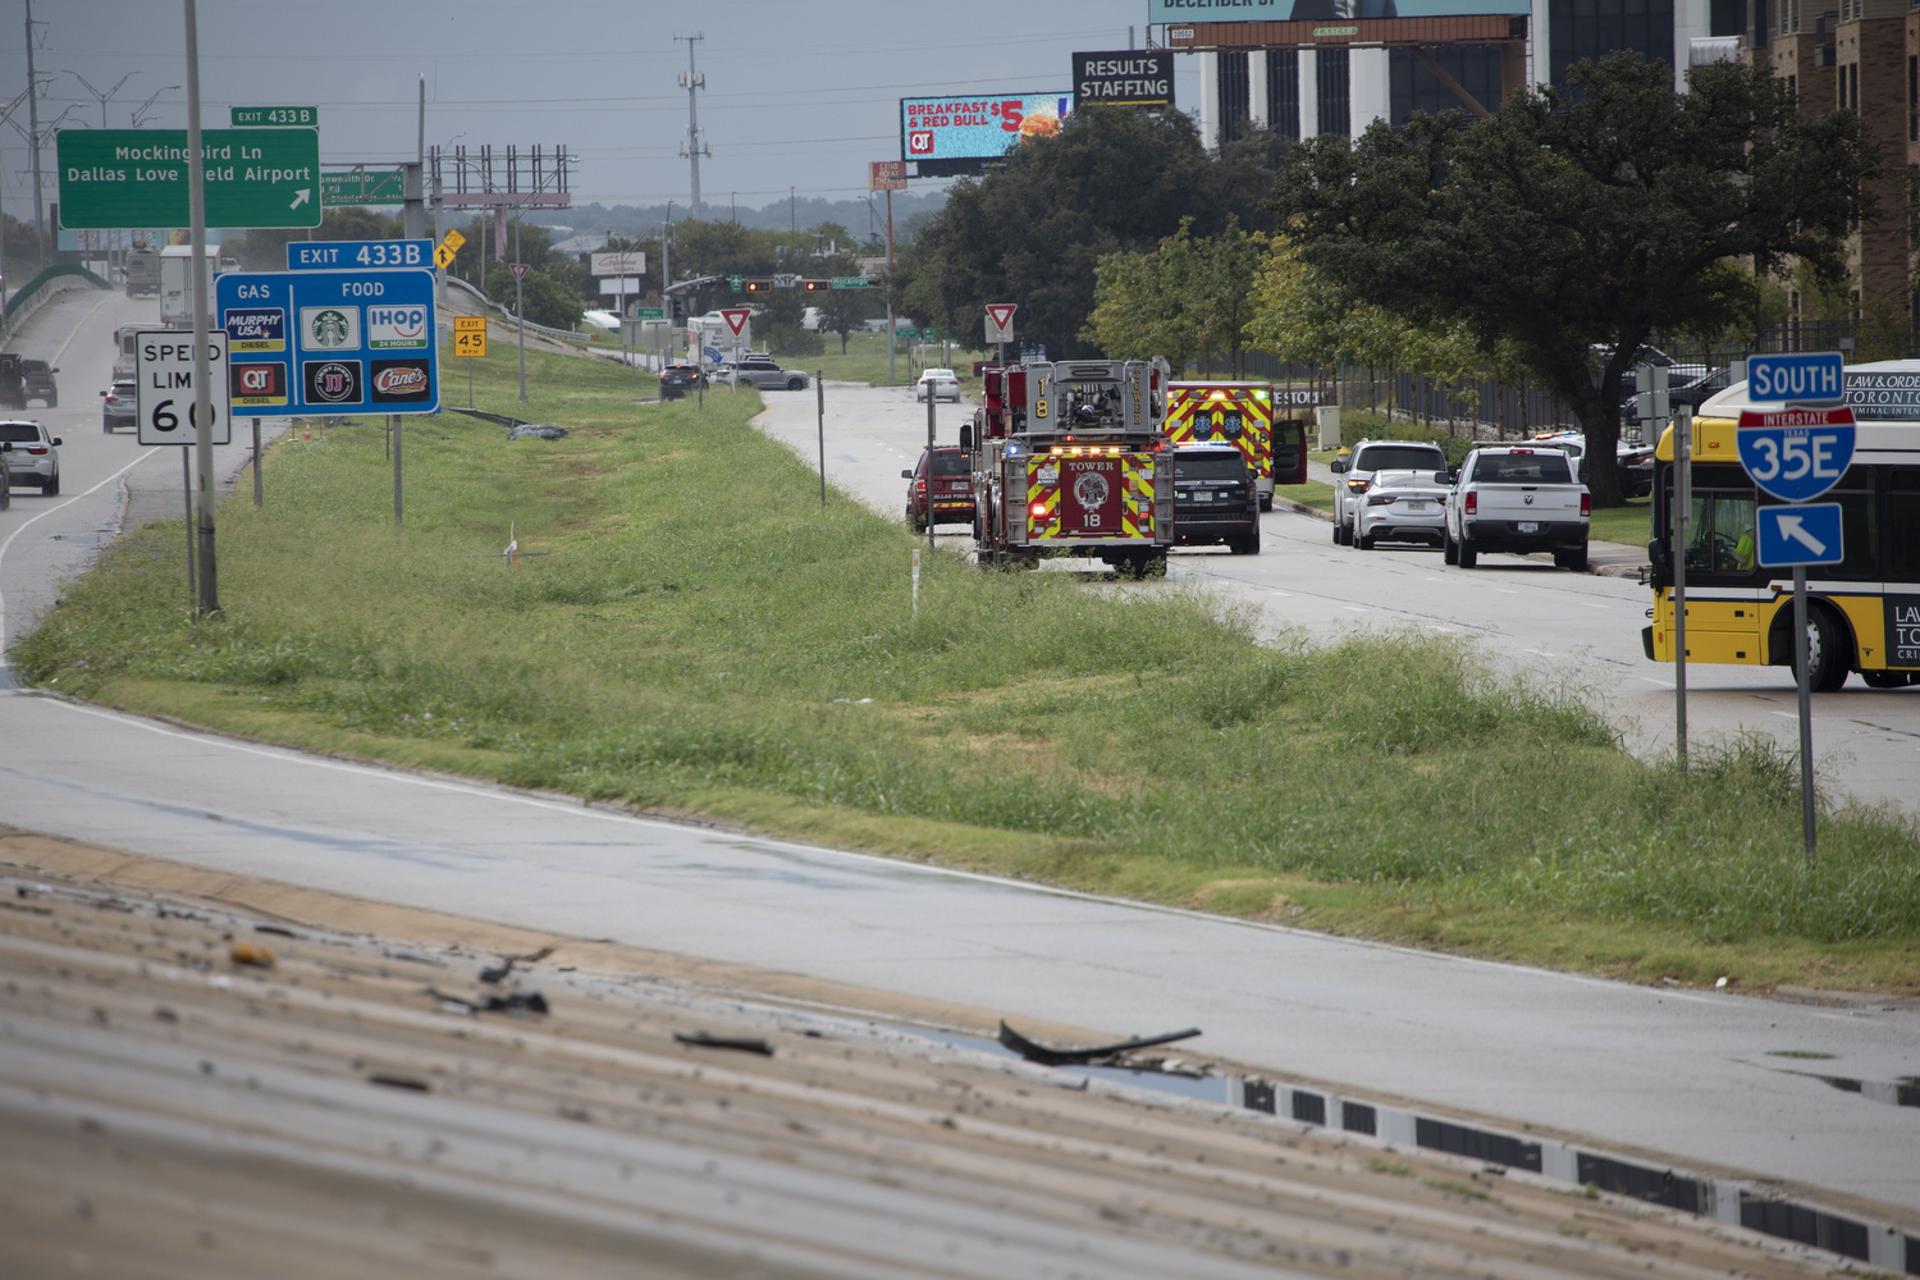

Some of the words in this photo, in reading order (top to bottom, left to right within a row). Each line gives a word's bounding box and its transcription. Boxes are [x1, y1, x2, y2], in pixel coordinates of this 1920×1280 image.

[1085, 59, 1158, 76] RESULTS
[1081, 80, 1168, 97] STAFFING
[908, 102, 989, 115] BREAKFAST
[238, 112, 262, 121] EXIT
[909, 117, 918, 128] &
[923, 116, 950, 127] RED
[953, 115, 989, 126] BULL
[911, 133, 930, 151] QT
[241, 146, 262, 160] Ln
[67, 167, 126, 181] Dallas
[136, 168, 179, 181] Love
[205, 166, 234, 181] eld
[244, 166, 310, 184] Airport
[300, 249, 339, 264] EXIT
[356, 244, 421, 265] 433B
[237, 284, 271, 299] GAS
[341, 282, 385, 297] FOOD
[227, 315, 282, 326] MURPHY
[237, 326, 262, 336] USA
[241, 341, 271, 349] DIESEL
[458, 335, 482, 347] 45
[144, 344, 221, 361] SPED
[153, 372, 213, 389] LIM
[243, 369, 269, 390] QT
[1755, 364, 1837, 396] SOUTH
[1846, 375, 1876, 388] LAW
[1763, 413, 1829, 427] INTERSTATE
[1784, 429, 1810, 437] TEXAS
[1751, 435, 1840, 481] 35E
[1069, 462, 1114, 471] TOWER
[1083, 514, 1101, 527] 18
